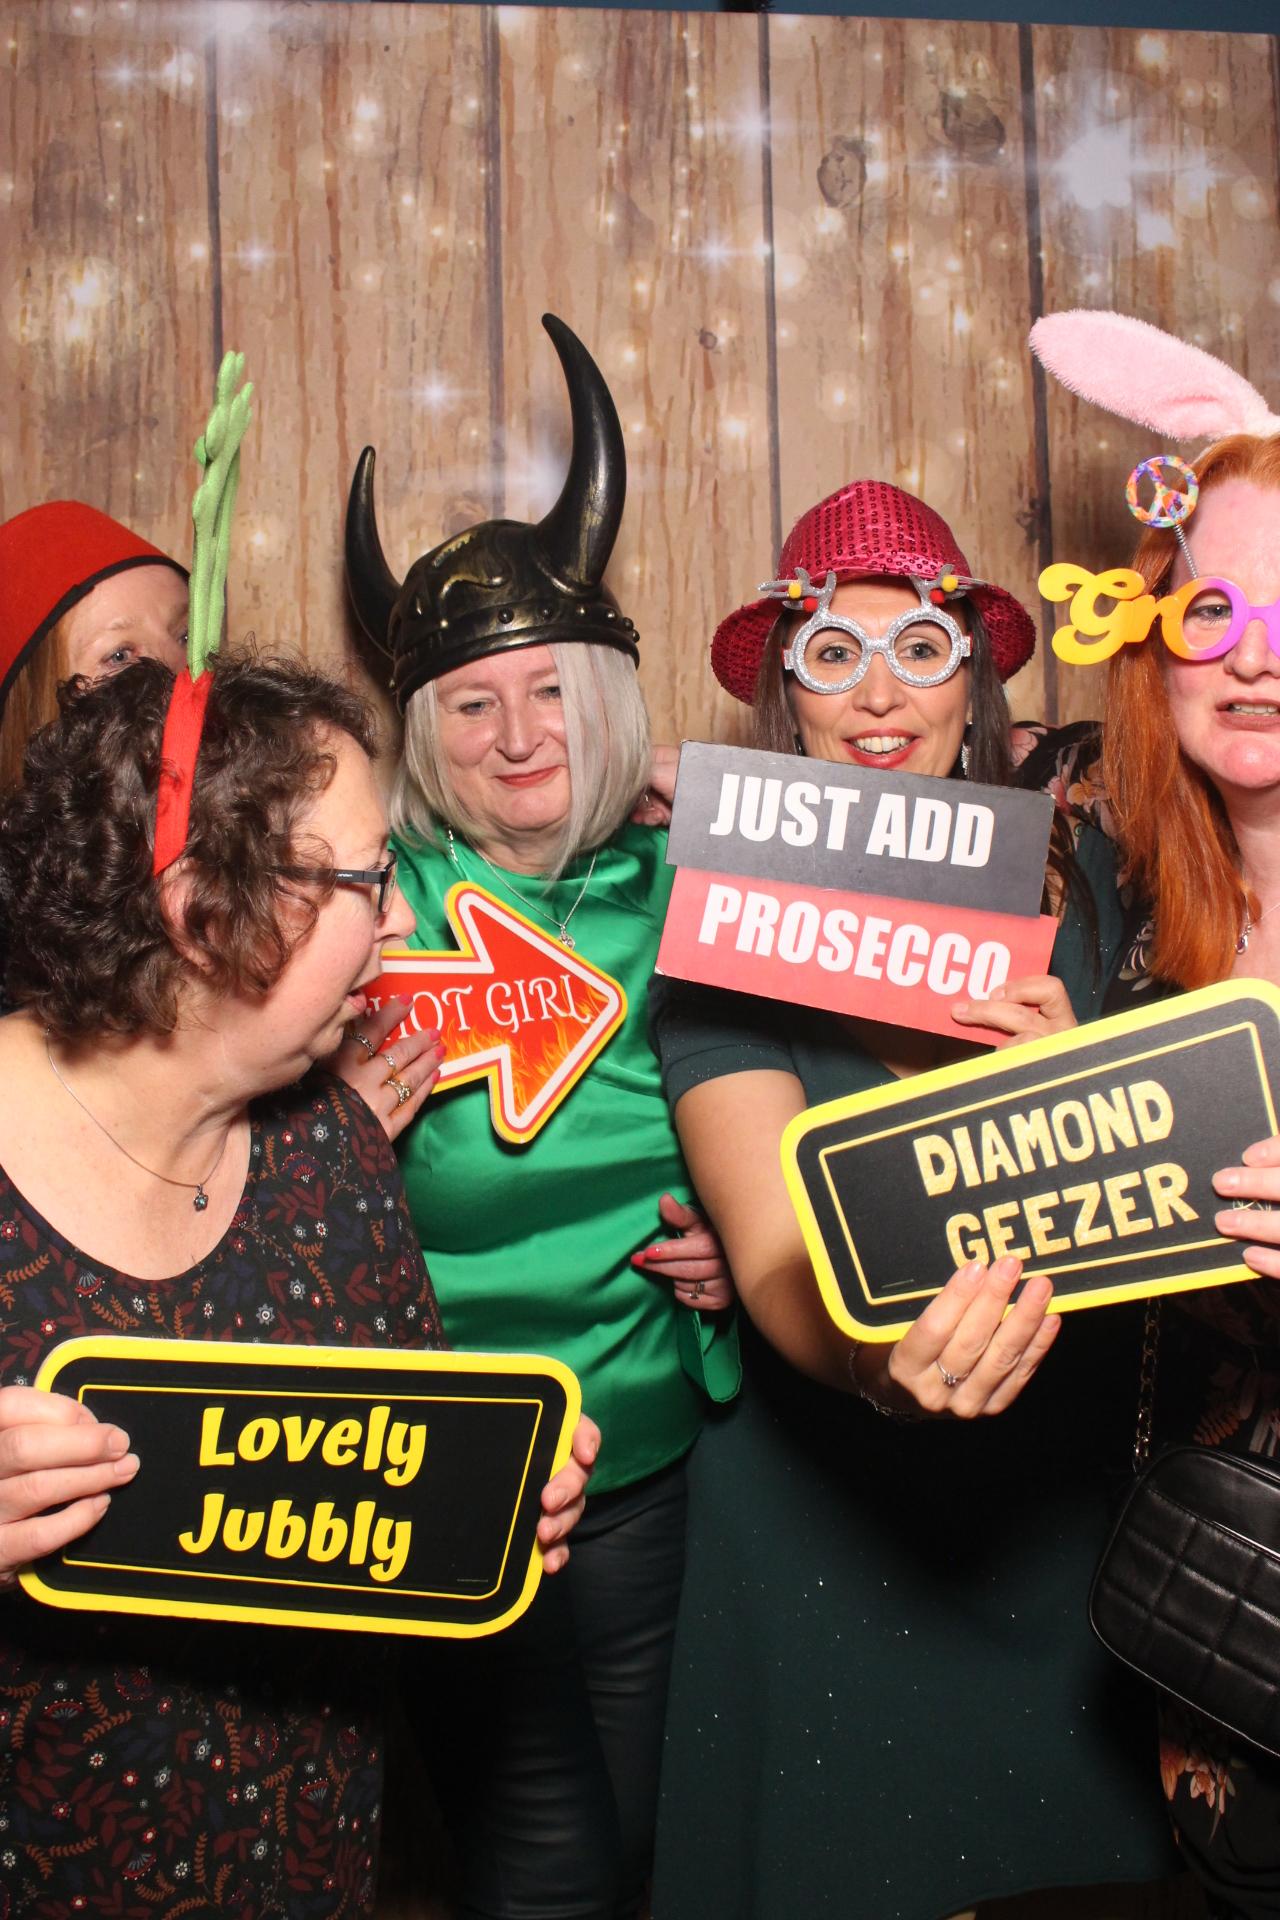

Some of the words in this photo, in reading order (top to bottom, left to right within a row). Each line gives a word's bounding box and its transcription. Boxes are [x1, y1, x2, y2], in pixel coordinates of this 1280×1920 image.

[709, 773, 861, 851] JUST
[865, 792, 995, 868] ADD
[698, 883, 1011, 1001] PROSECCO
[486, 974, 591, 1033] GIRL
[913, 1080, 1175, 1197] DIAMOND
[945, 1162, 1199, 1271] GEEZER
[199, 1406, 427, 1487] Lovely
[178, 1493, 412, 1583] Jubbly
